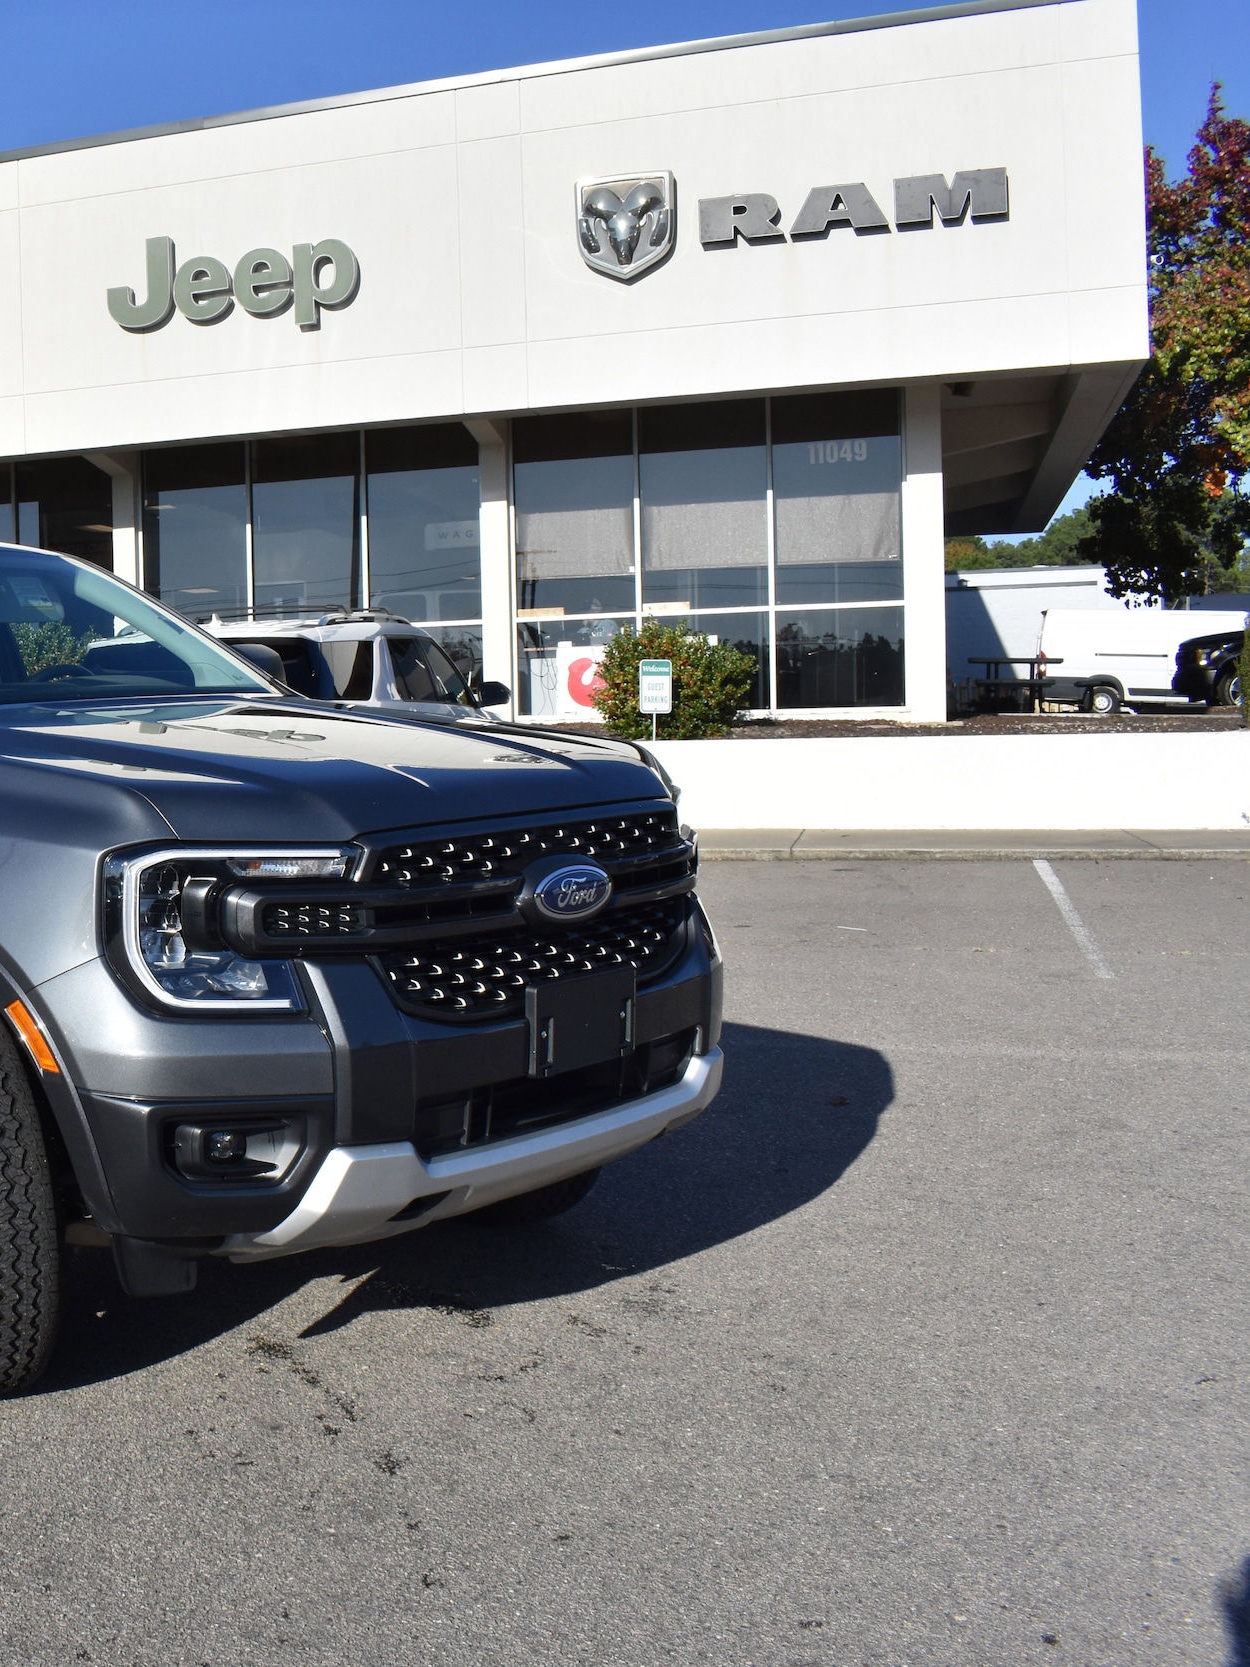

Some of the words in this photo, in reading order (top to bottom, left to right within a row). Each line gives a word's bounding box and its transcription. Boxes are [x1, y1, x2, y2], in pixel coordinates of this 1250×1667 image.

[697, 167, 1009, 251] RAM
[107, 236, 361, 334] Jeep
[807, 439, 868, 465] 11049
[437, 529, 474, 540] WAG
[642, 664, 670, 673] Welcome
[647, 682, 665, 691] GUEST
[643, 695, 668, 704] PARKING
[557, 876, 598, 909] Ford
